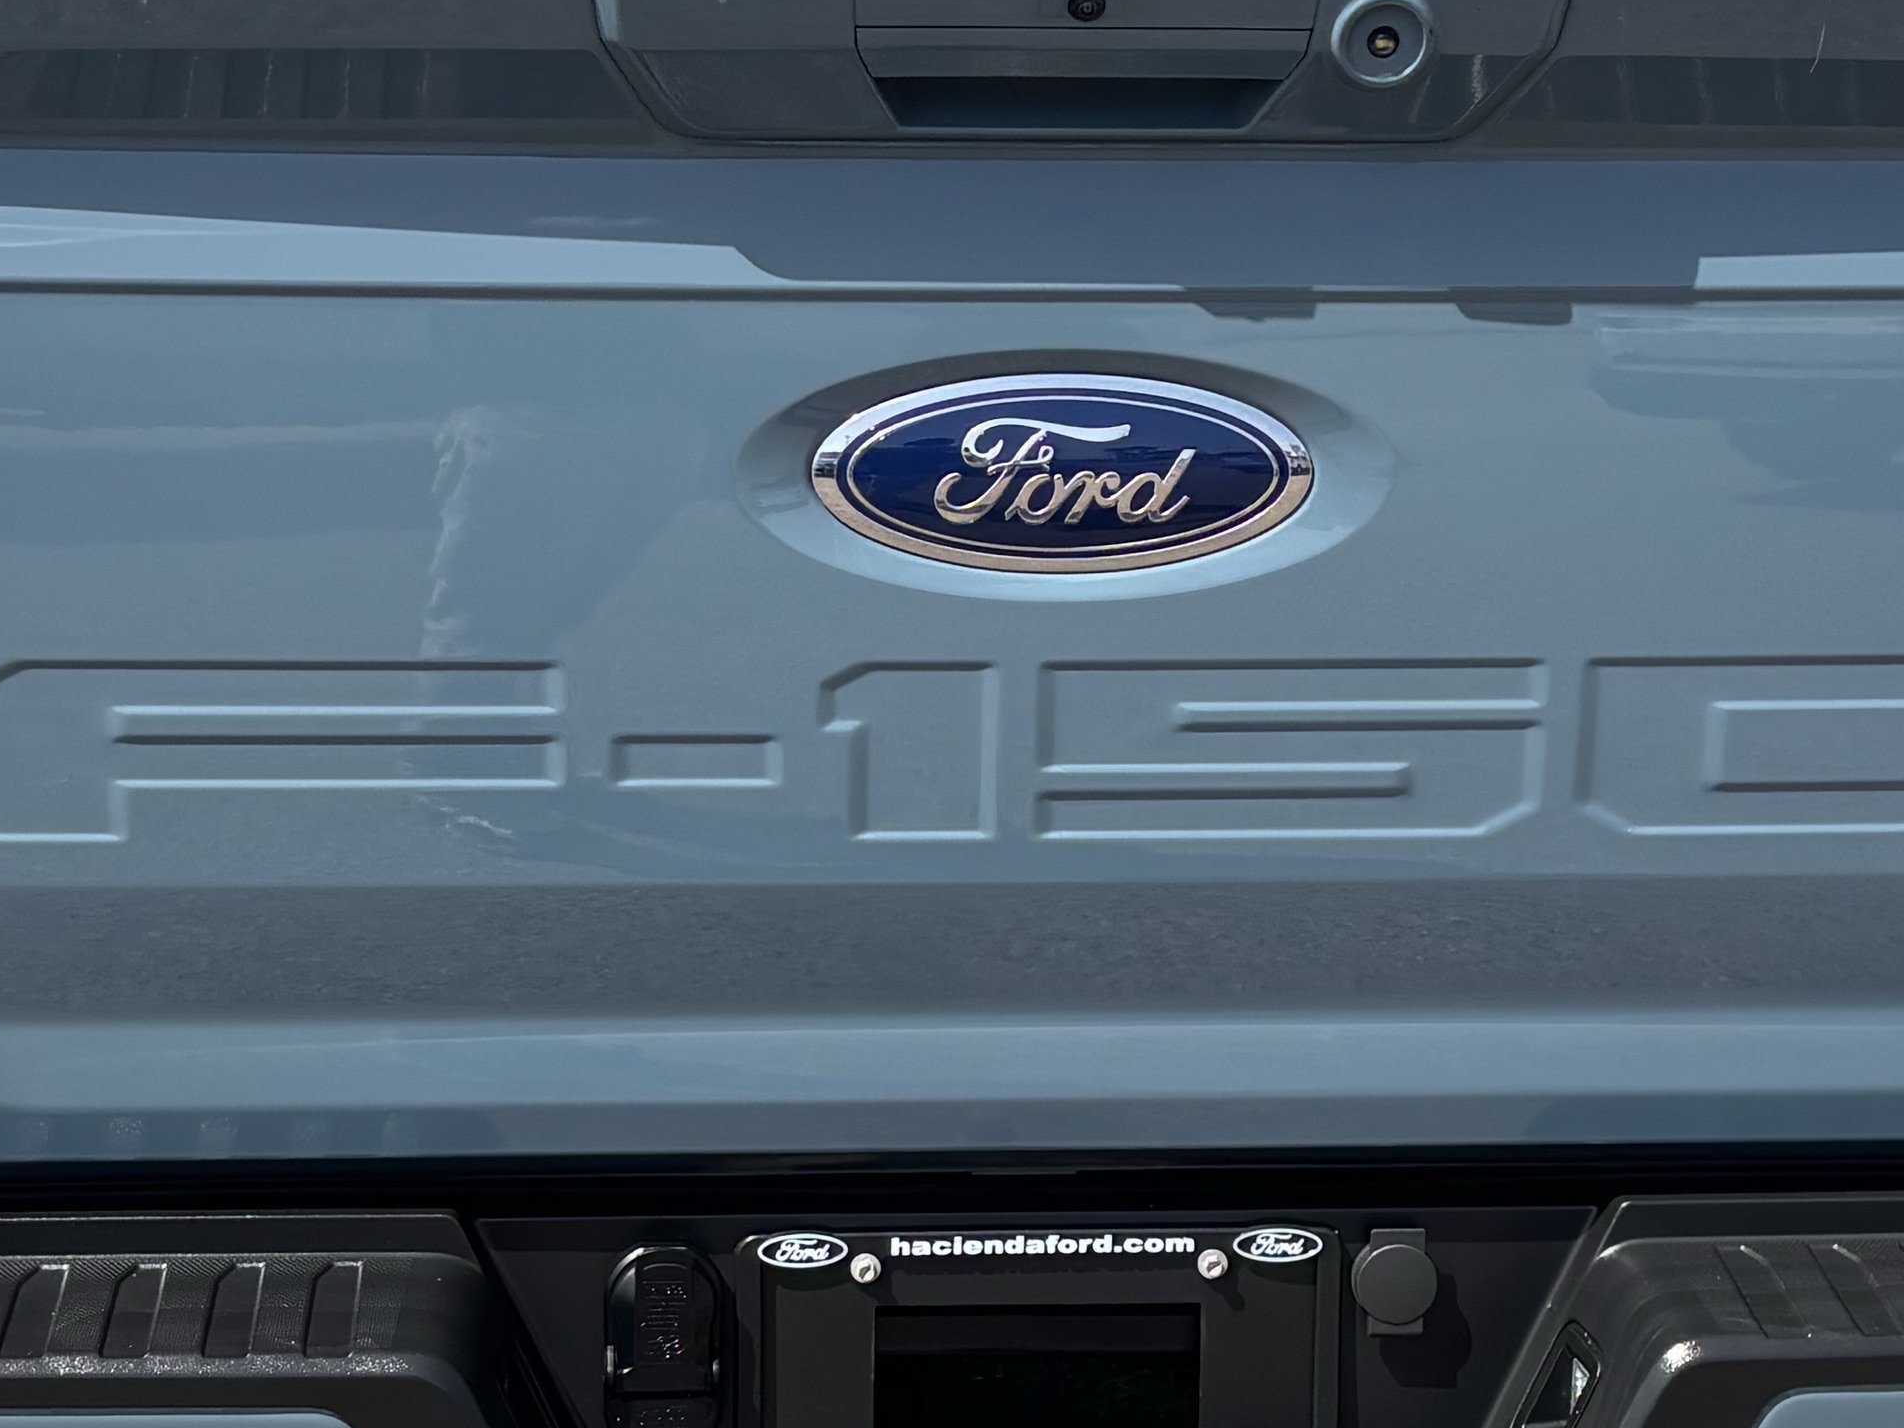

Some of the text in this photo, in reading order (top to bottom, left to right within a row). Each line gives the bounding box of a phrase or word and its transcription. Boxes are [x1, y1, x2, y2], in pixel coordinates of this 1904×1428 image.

[933, 417, 1196, 527] Ford
[775, 1233, 1305, 1262] Ford haciendaford.com Ford
